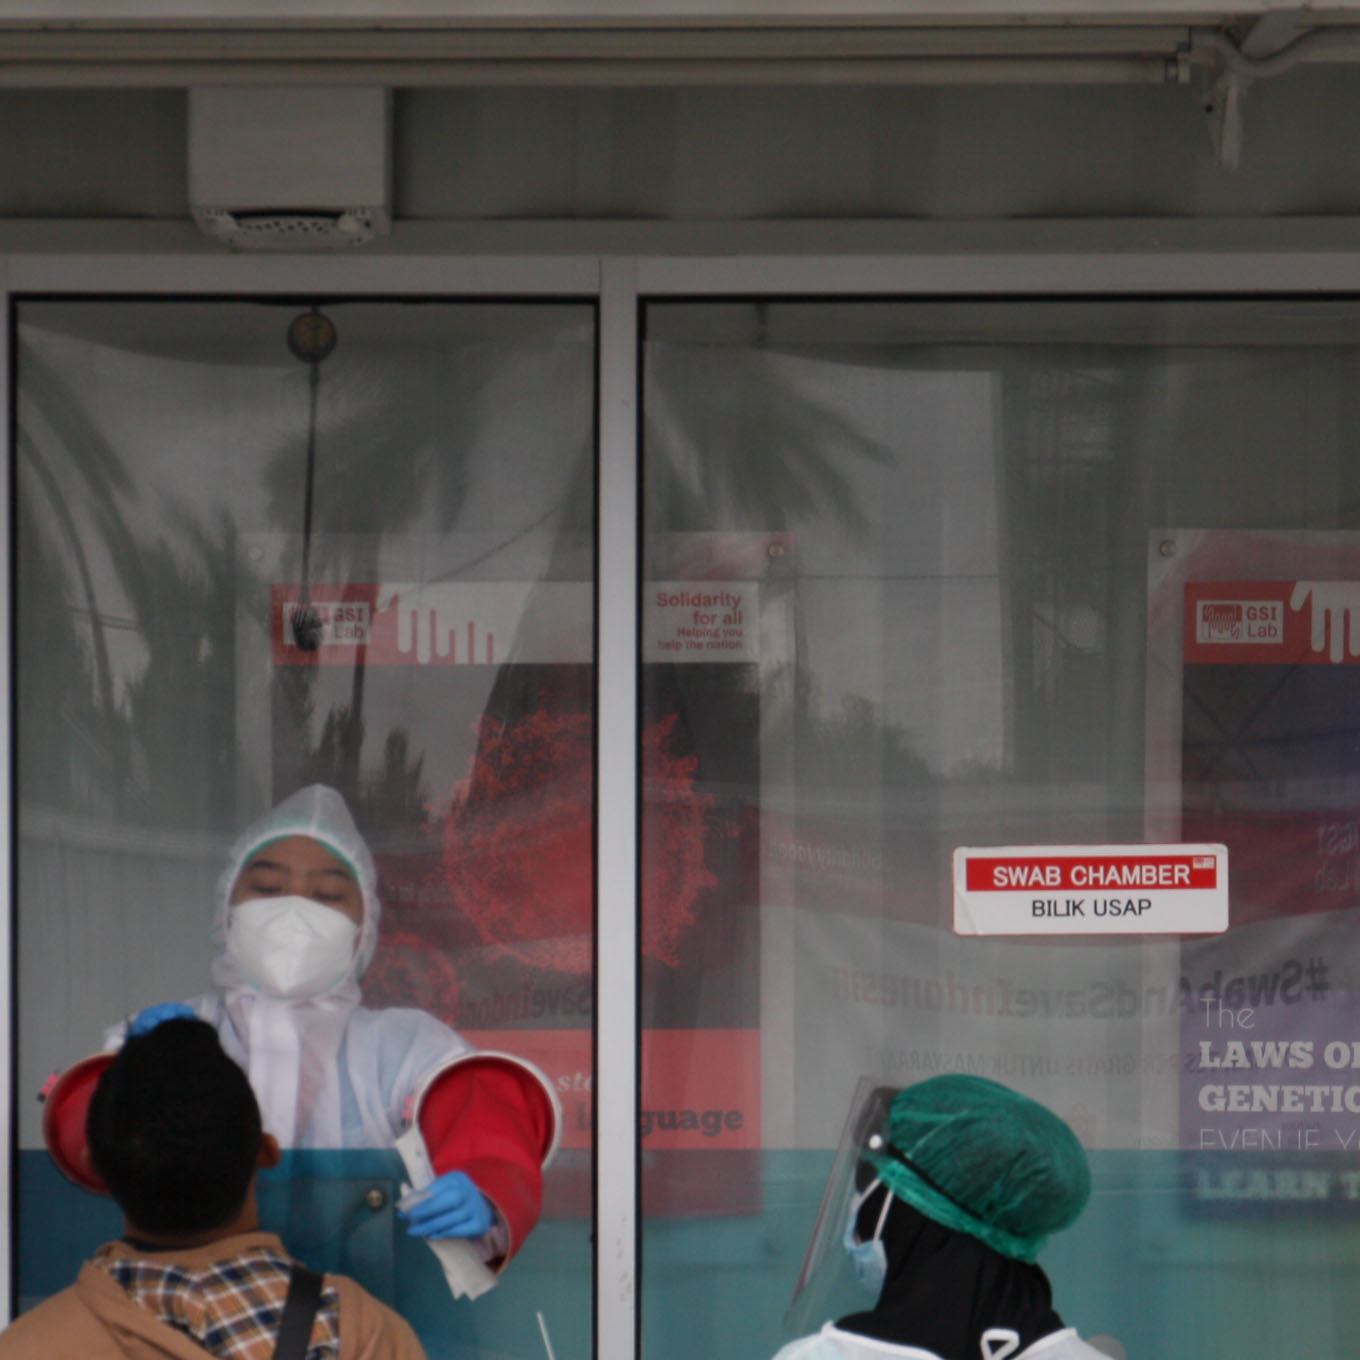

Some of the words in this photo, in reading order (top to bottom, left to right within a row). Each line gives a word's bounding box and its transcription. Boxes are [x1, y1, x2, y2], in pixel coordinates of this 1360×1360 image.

[657, 592, 743, 610] Solidarity
[693, 611, 717, 624] for
[723, 611, 743, 624] all
[1247, 606, 1277, 621] GSI
[335, 625, 364, 640] Lab
[677, 628, 720, 639] Helping
[723, 630, 743, 639] you
[1248, 623, 1277, 638] Lab
[657, 640, 682, 650] help
[686, 640, 703, 649] the
[707, 640, 742, 649] nation
[993, 865, 1061, 887] SWAB
[1070, 864, 1191, 886] CHAMBER
[1032, 899, 1086, 917] BILIK
[1093, 899, 1152, 917] USAP
[1200, 998, 1255, 1029] The
[1200, 1041, 1314, 1069] LAWS
[1200, 1129, 1280, 1151] EVEN
[1298, 1129, 1321, 1151] IF
[1199, 1169, 1330, 1201] LEARN
